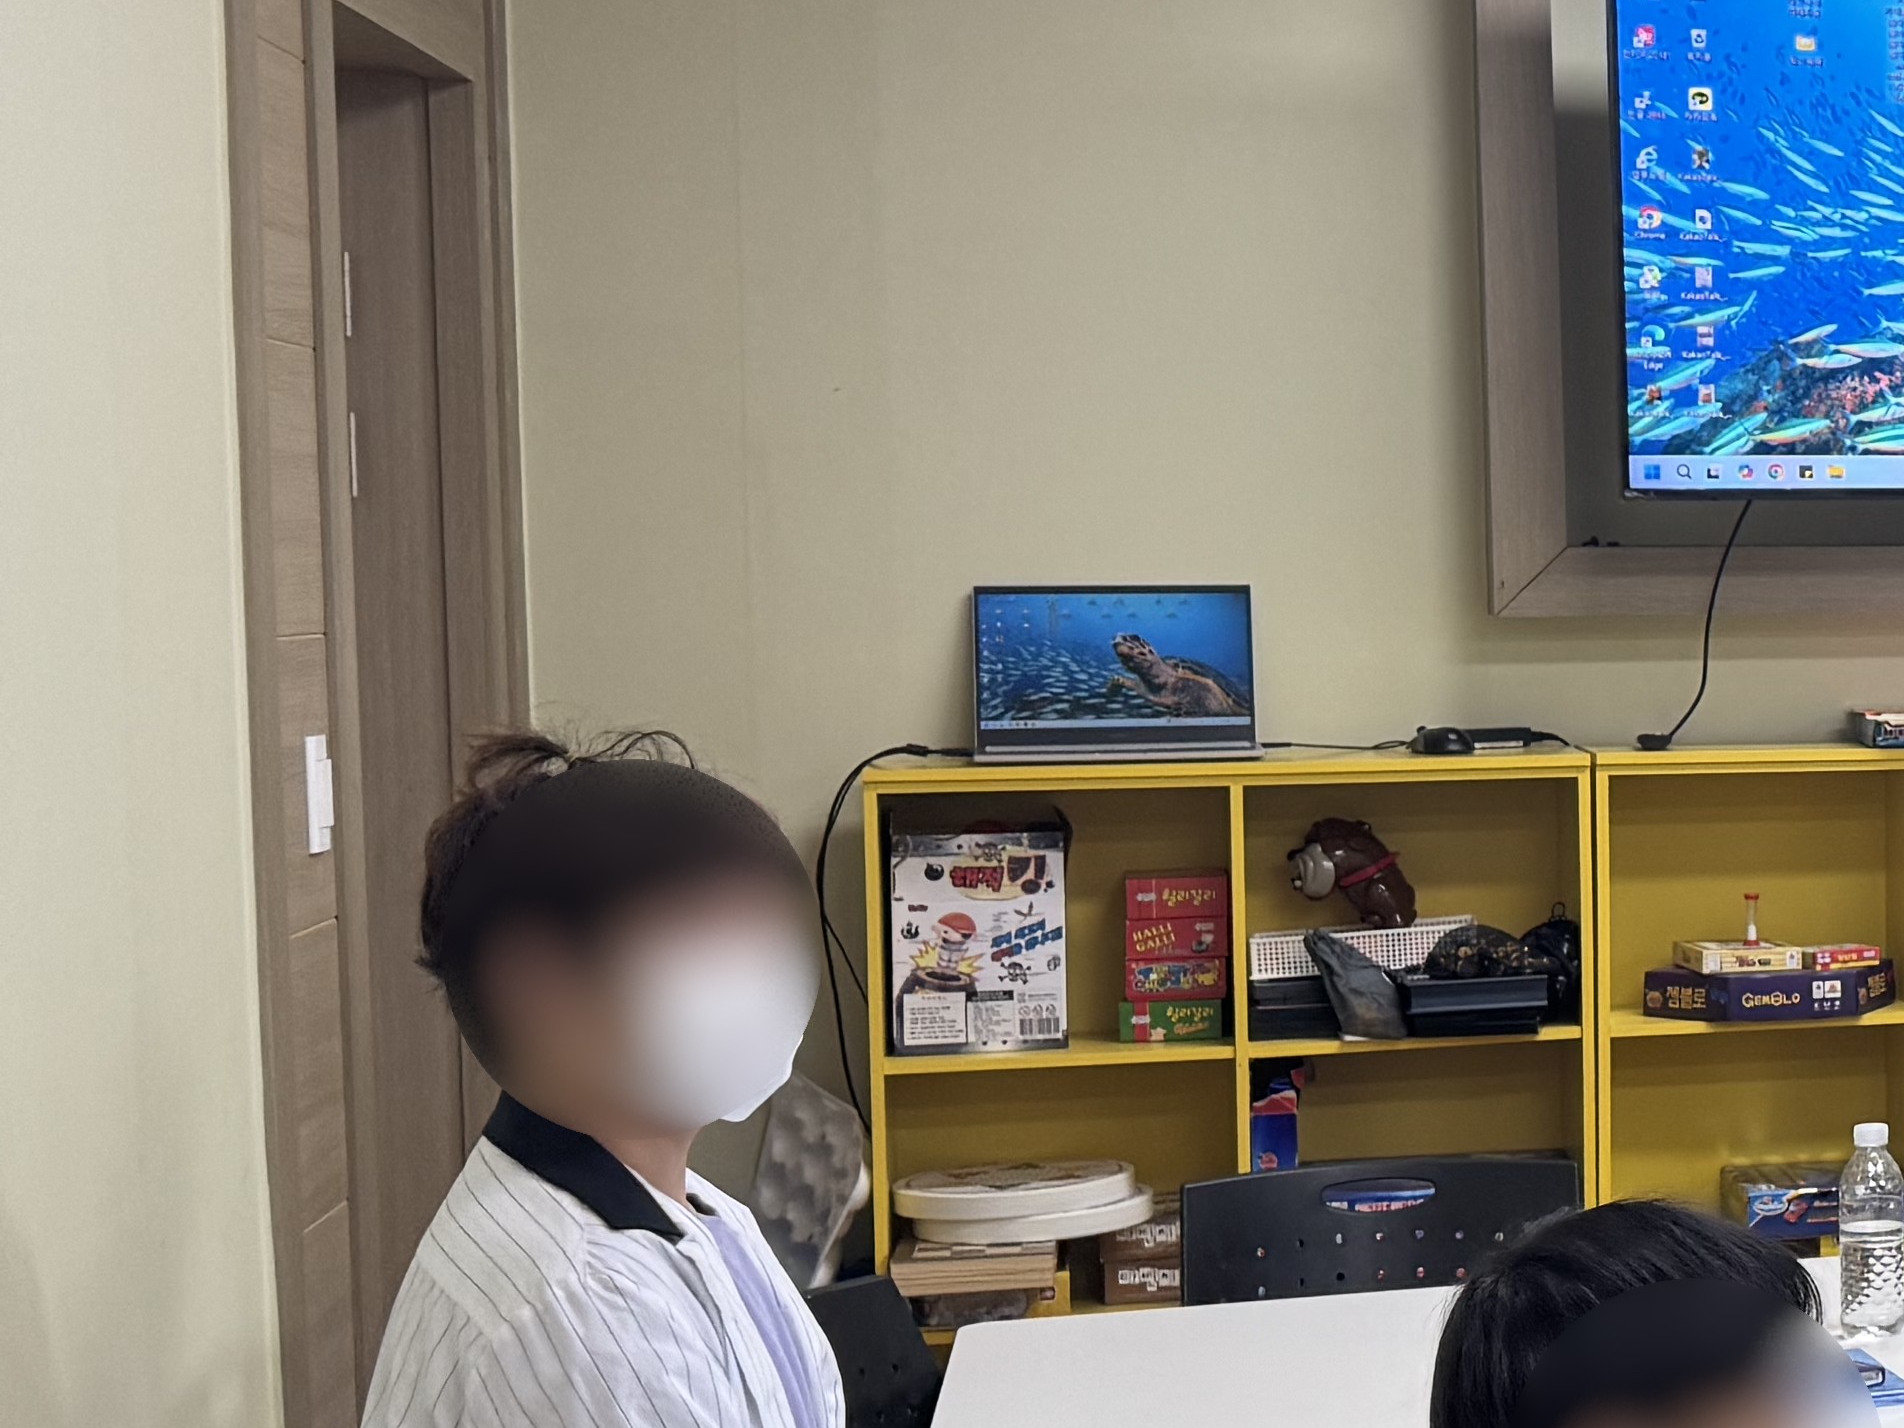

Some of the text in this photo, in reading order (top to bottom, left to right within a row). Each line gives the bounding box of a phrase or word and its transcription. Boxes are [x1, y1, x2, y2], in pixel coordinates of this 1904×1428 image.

[1132, 922, 1172, 943] HALLI
[1136, 933, 1176, 952] GALLI
[1667, 986, 1707, 1010] 젬블로
